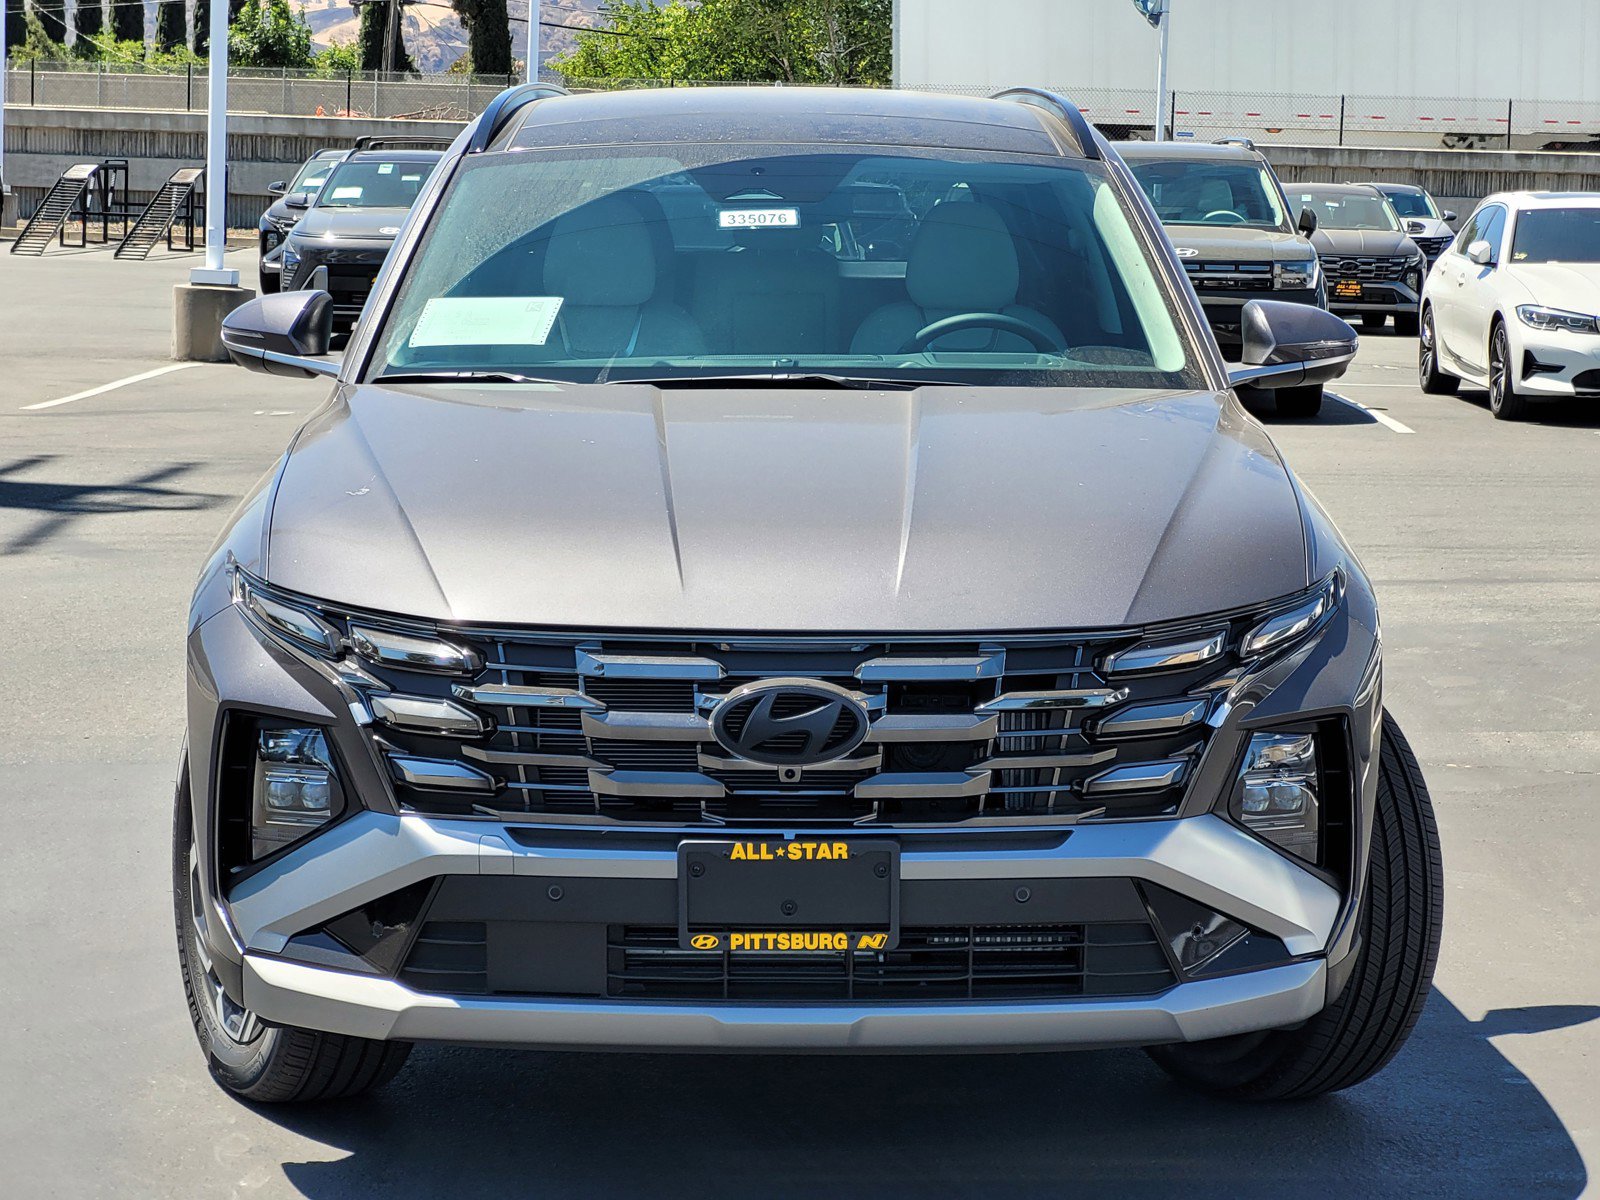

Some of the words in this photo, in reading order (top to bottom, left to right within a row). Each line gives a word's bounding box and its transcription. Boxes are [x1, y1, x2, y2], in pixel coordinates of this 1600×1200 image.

[727, 213, 788, 225] 335076
[730, 843, 774, 860] ALL
[787, 843, 848, 860] STAR
[730, 933, 848, 950] PITTSBURG
